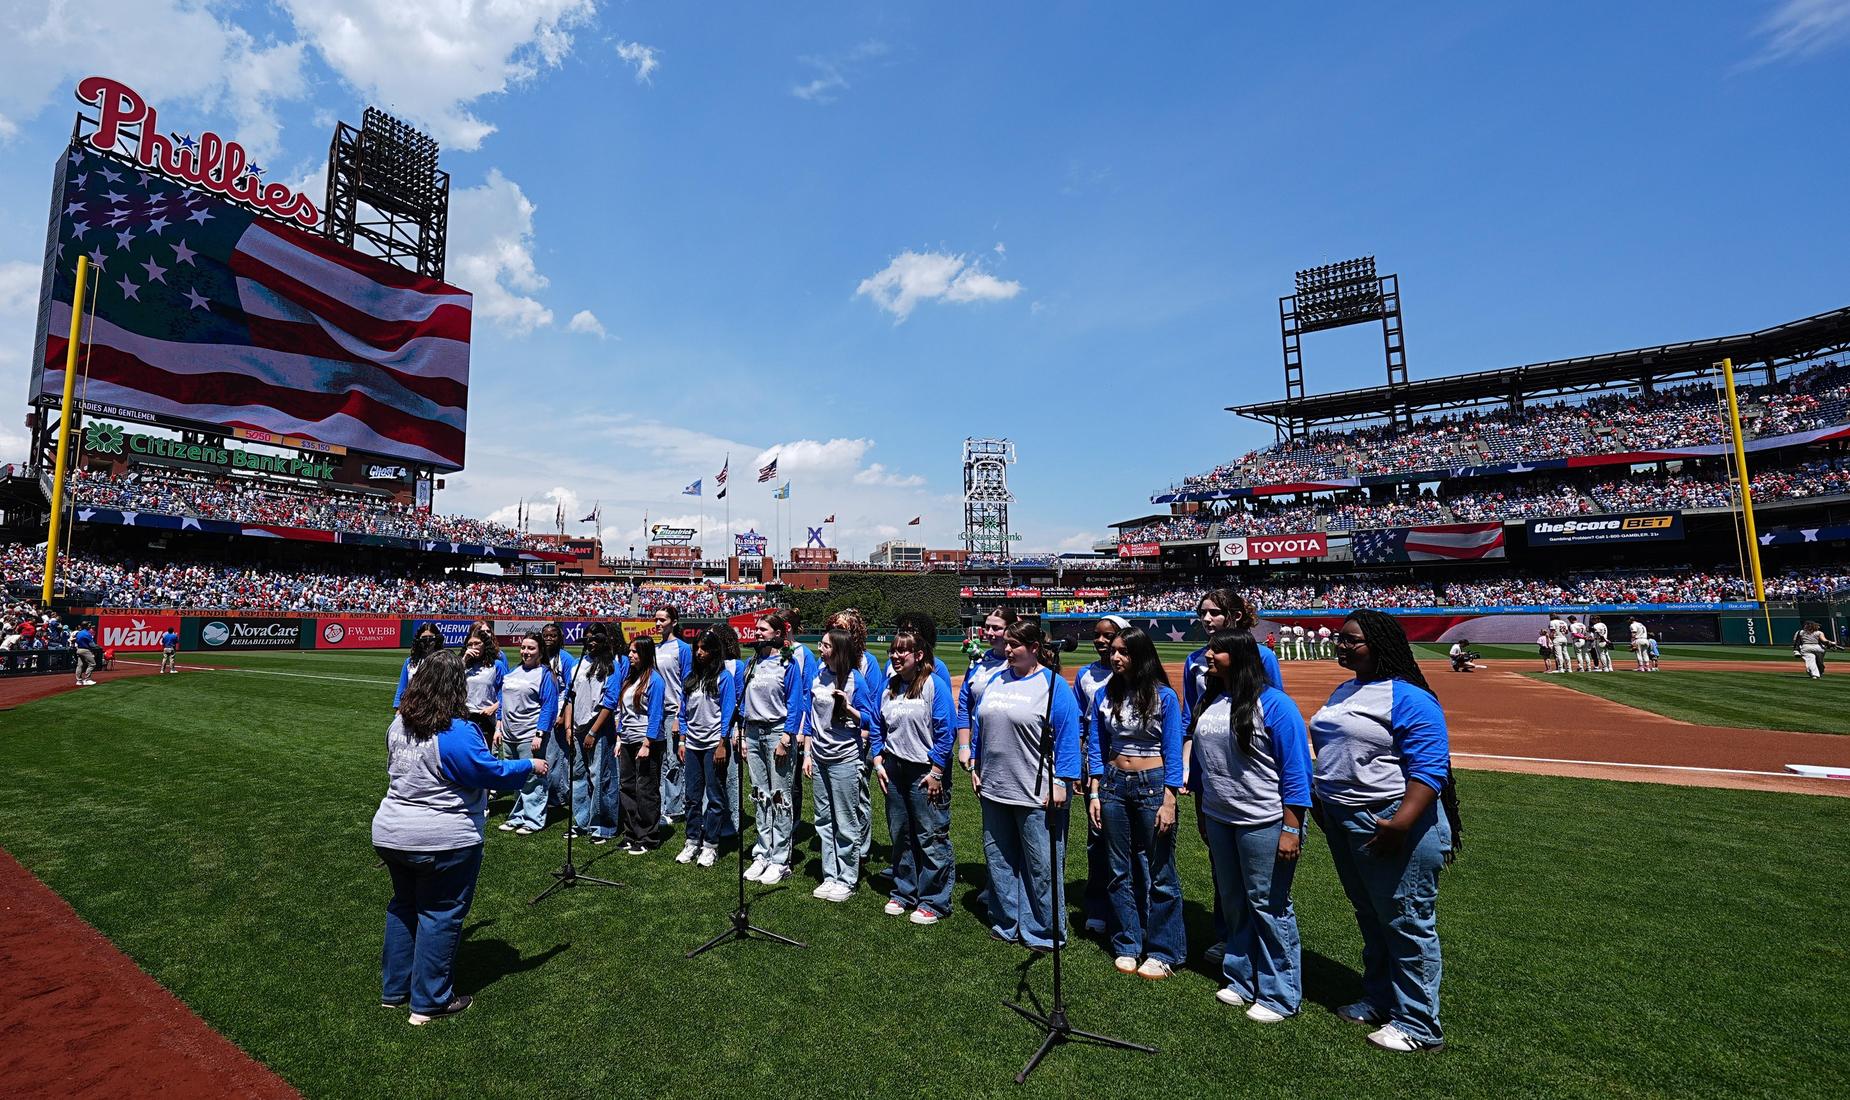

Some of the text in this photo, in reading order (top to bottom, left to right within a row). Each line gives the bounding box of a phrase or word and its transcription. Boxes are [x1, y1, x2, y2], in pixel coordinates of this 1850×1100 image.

[76, 76, 319, 226] Phillies
[79, 400, 102, 412] LADIES
[103, 406, 117, 415] AND
[118, 408, 157, 421] GENTLEMEN.
[130, 434, 228, 464] Citizens
[232, 448, 288, 473] Bank
[290, 458, 334, 480] Park
[1534, 517, 1668, 533] theScore BET
[1251, 539, 1320, 553] TOYOTA
[231, 623, 298, 636] NovaCare
[367, 627, 396, 635] WEBB
[435, 622, 469, 632] SHERWI
[742, 627, 755, 639] Sta
